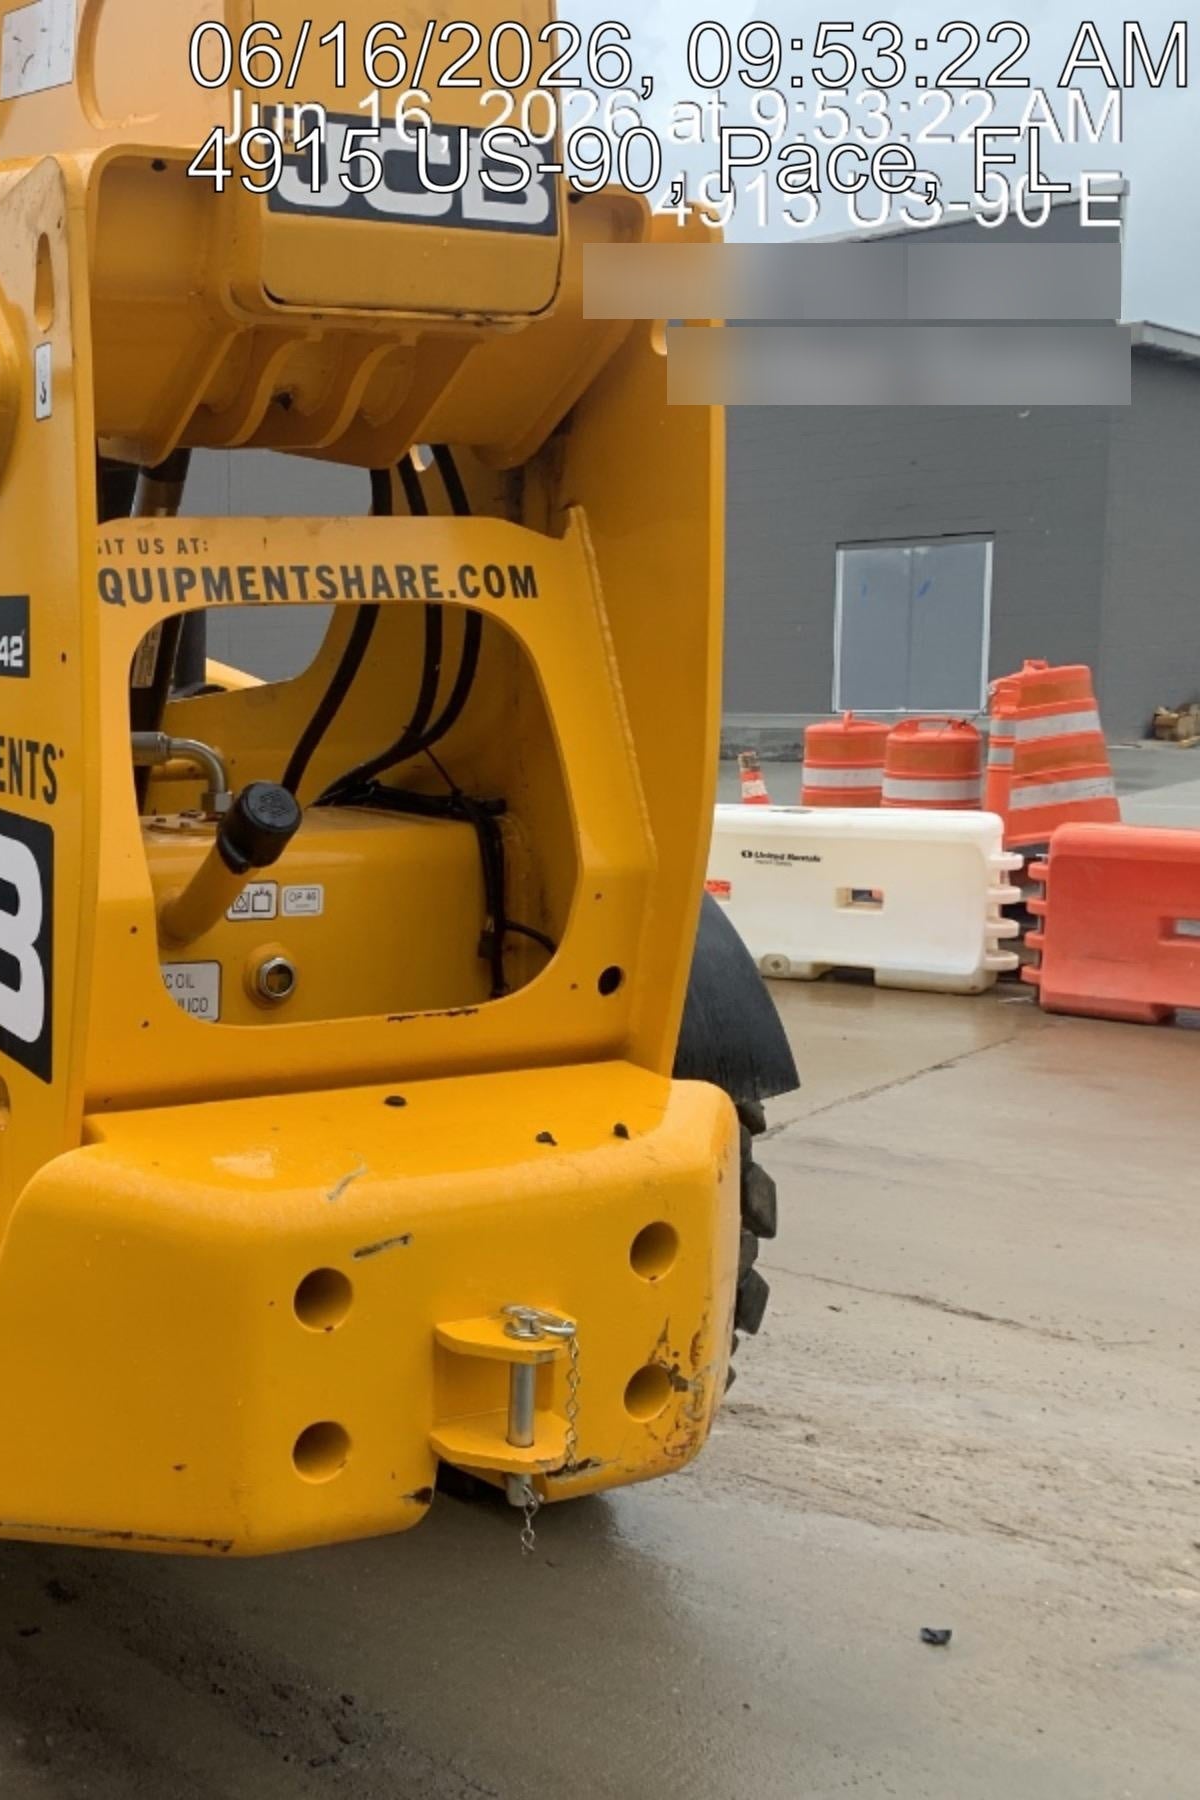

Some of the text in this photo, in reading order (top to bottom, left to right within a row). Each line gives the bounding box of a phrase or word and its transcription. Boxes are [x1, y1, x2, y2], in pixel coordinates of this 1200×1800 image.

[273, 120, 551, 226] JCB
[98, 537, 209, 556] IT US AT:
[97, 563, 539, 607] QUIPMENTSHARE.COM
[754, 851, 785, 861] United
[175, 973, 195, 989] OIL
